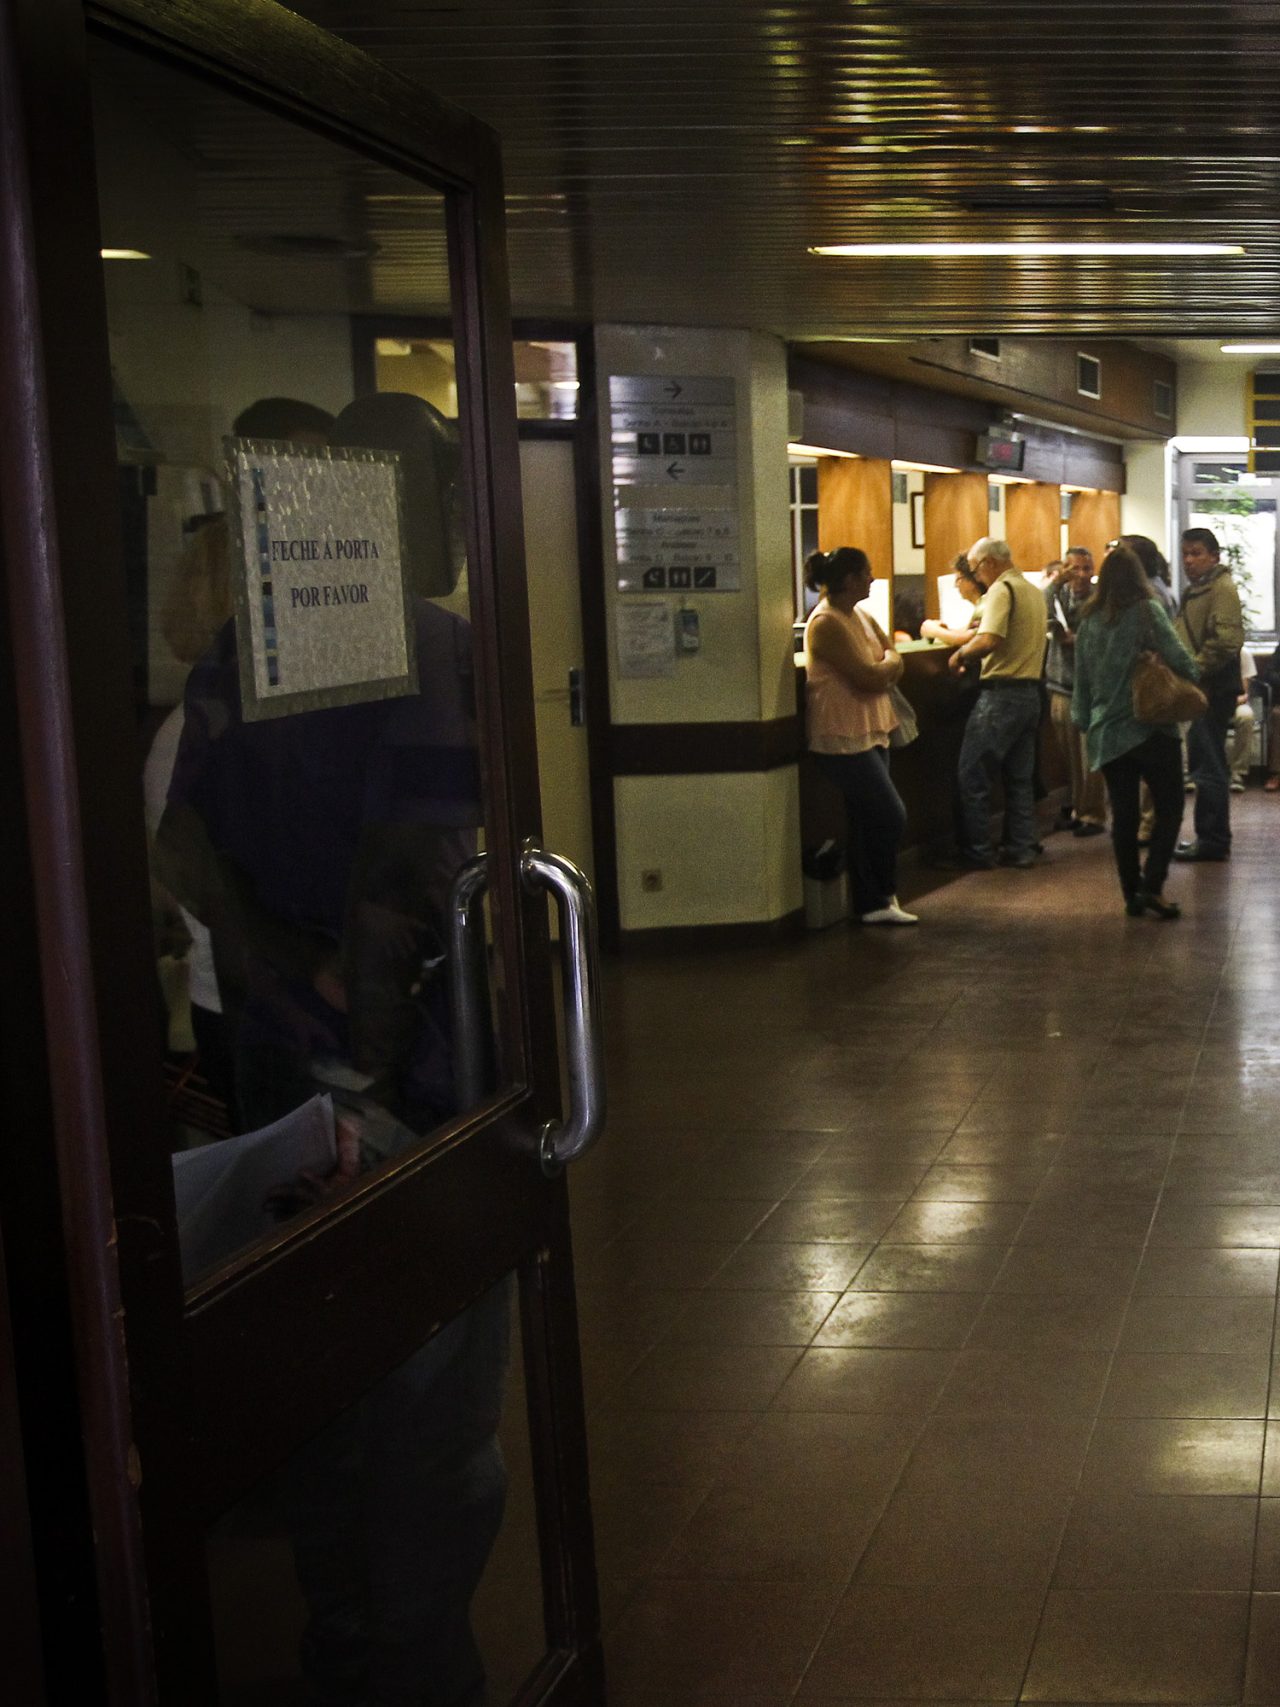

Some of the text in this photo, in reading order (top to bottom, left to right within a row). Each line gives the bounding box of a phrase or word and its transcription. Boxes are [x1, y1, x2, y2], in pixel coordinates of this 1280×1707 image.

[272, 539, 380, 561] FECHE A PORTA
[291, 584, 369, 608] POR FAVOR
